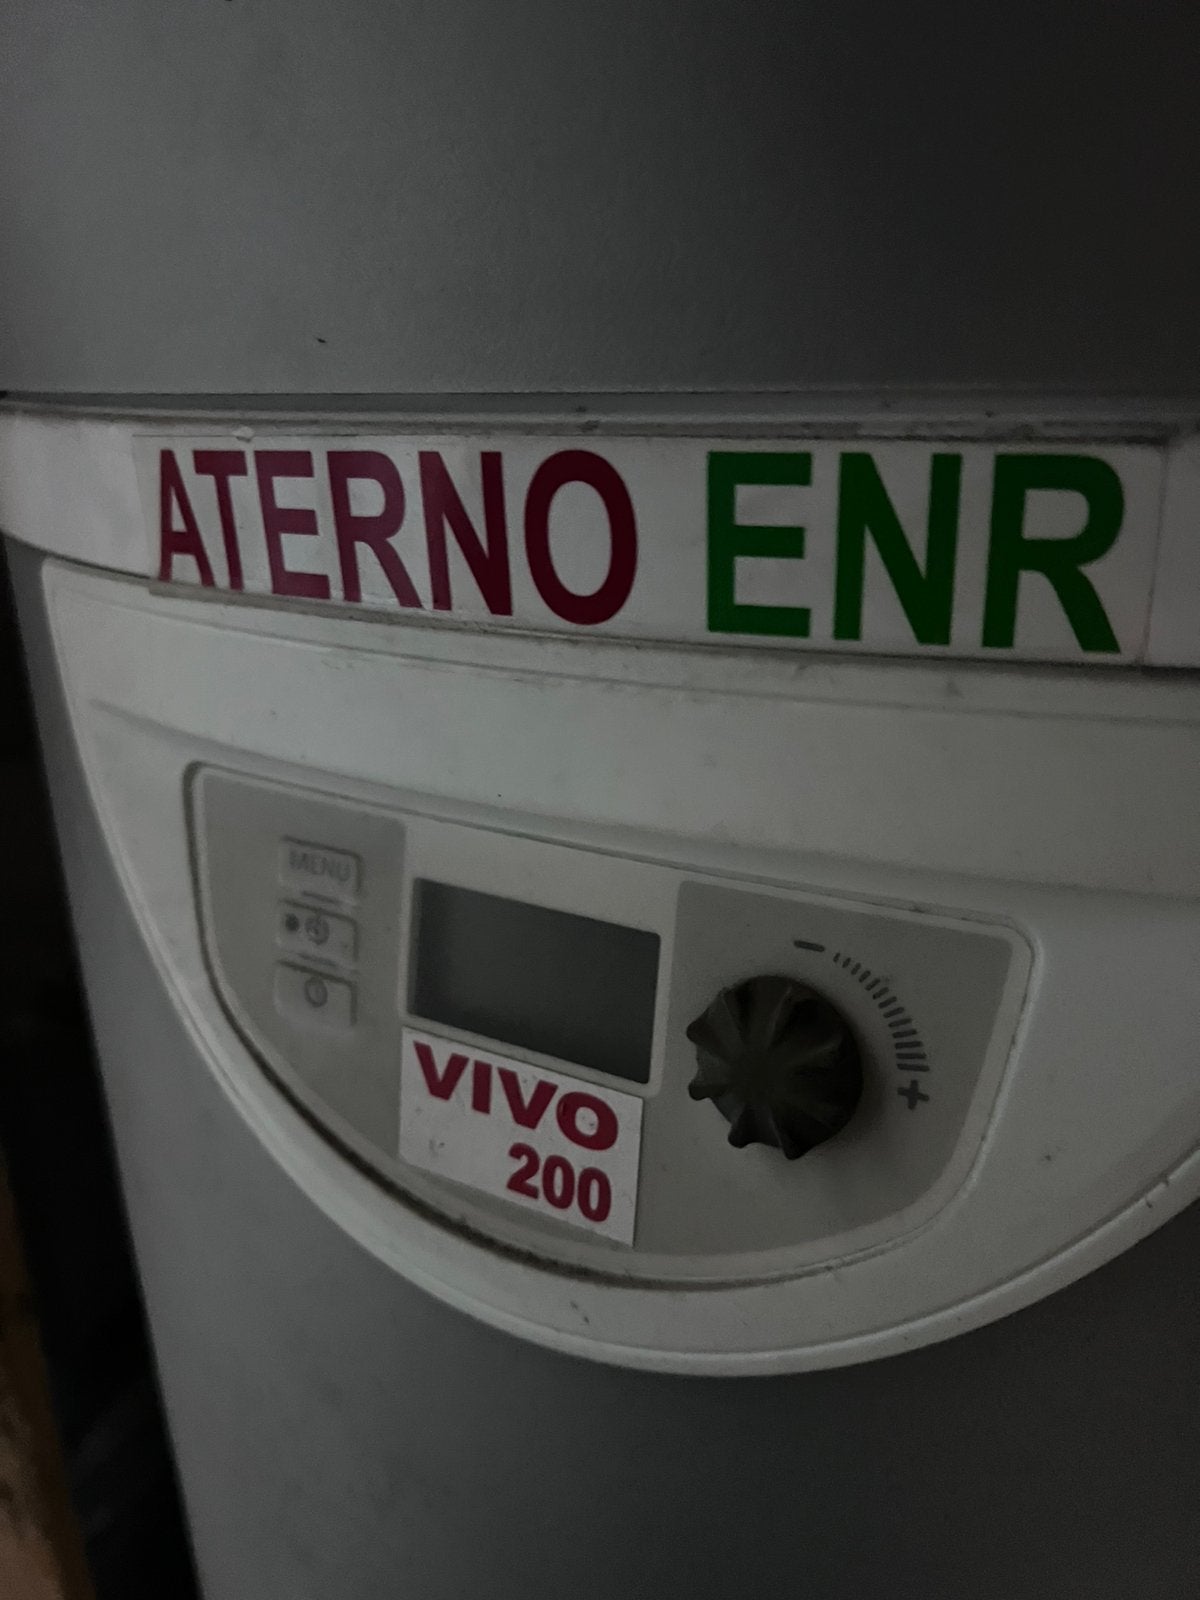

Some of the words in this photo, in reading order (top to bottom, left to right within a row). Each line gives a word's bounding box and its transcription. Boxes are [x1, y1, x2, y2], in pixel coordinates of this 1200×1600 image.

[158, 450, 637, 624] ATERNO
[708, 451, 1124, 653] ENR
[289, 850, 351, 882] MENU
[413, 1040, 618, 1151] VIVO
[507, 1143, 611, 1222] 200
